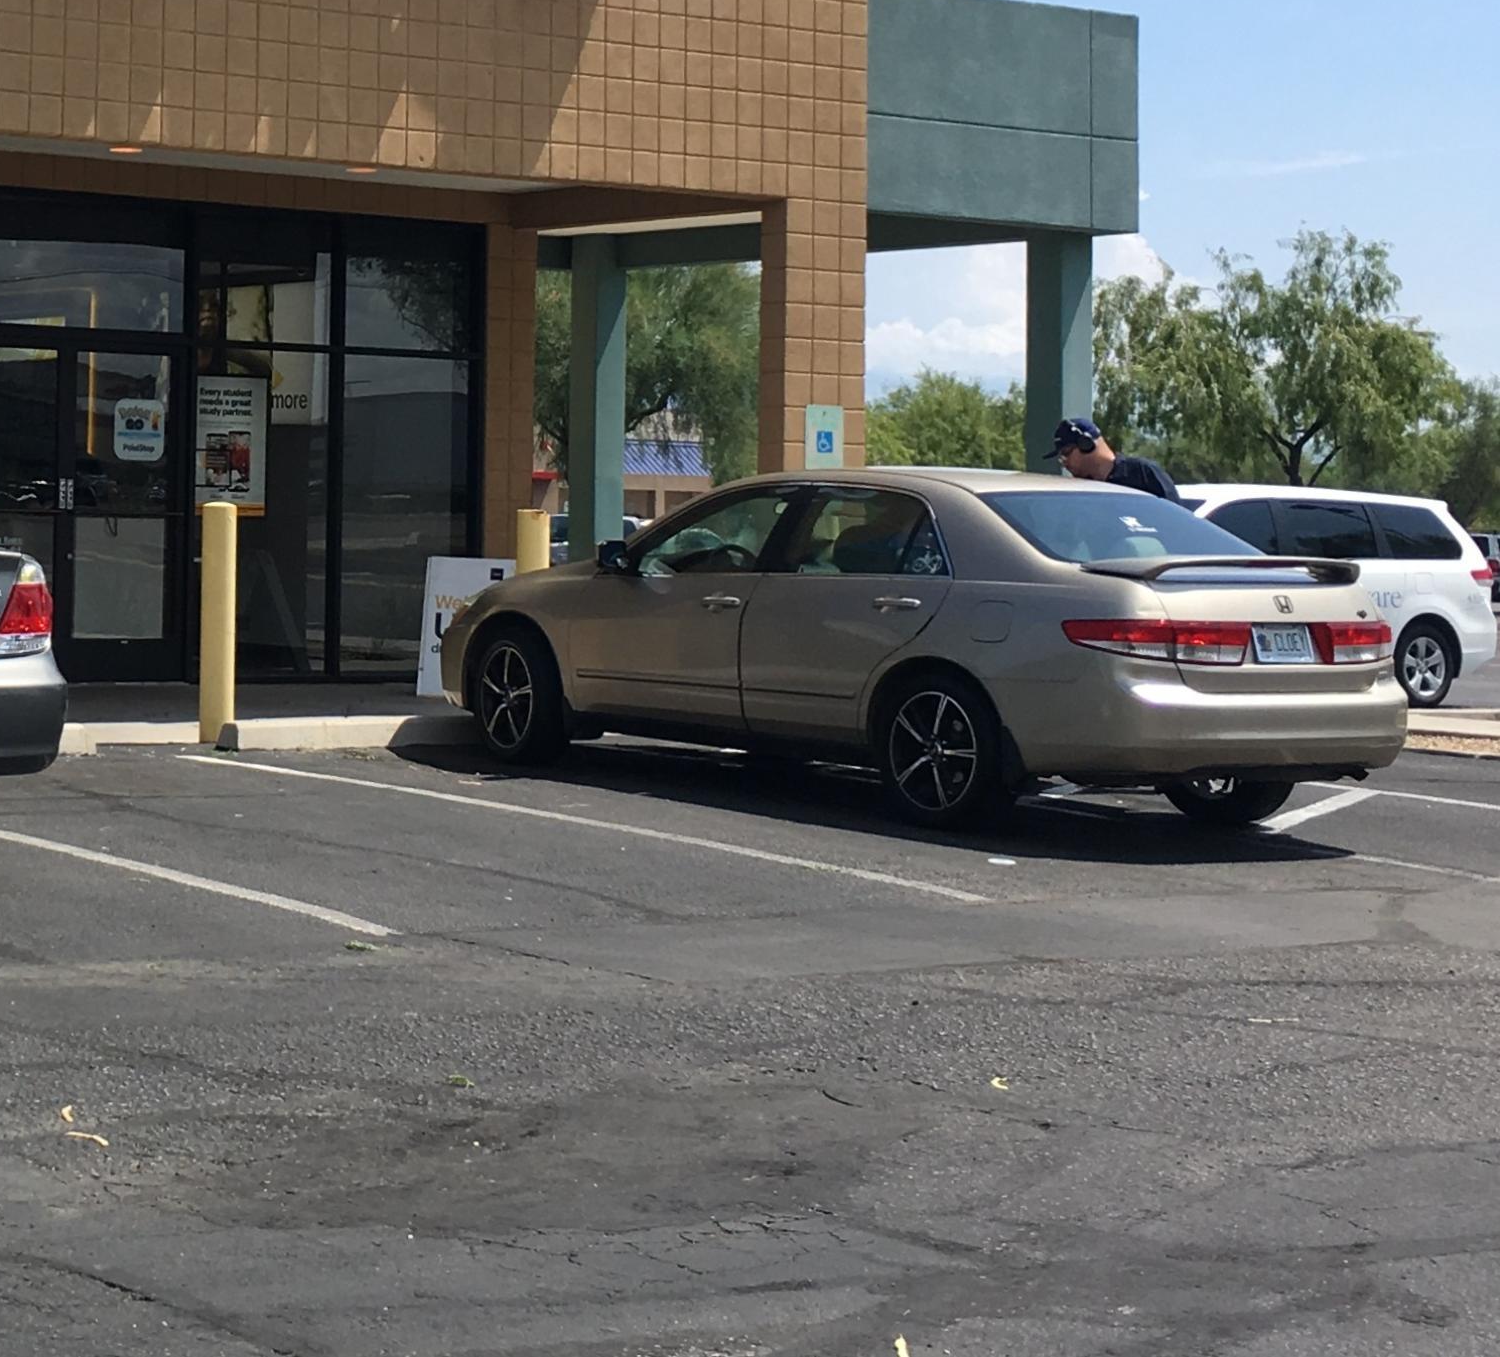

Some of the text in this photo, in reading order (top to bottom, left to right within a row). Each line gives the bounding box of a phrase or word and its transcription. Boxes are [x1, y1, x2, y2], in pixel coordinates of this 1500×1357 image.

[200, 388, 252, 399] Every student
[231, 398, 252, 408] great
[271, 394, 308, 409] more
[199, 407, 220, 417] study
